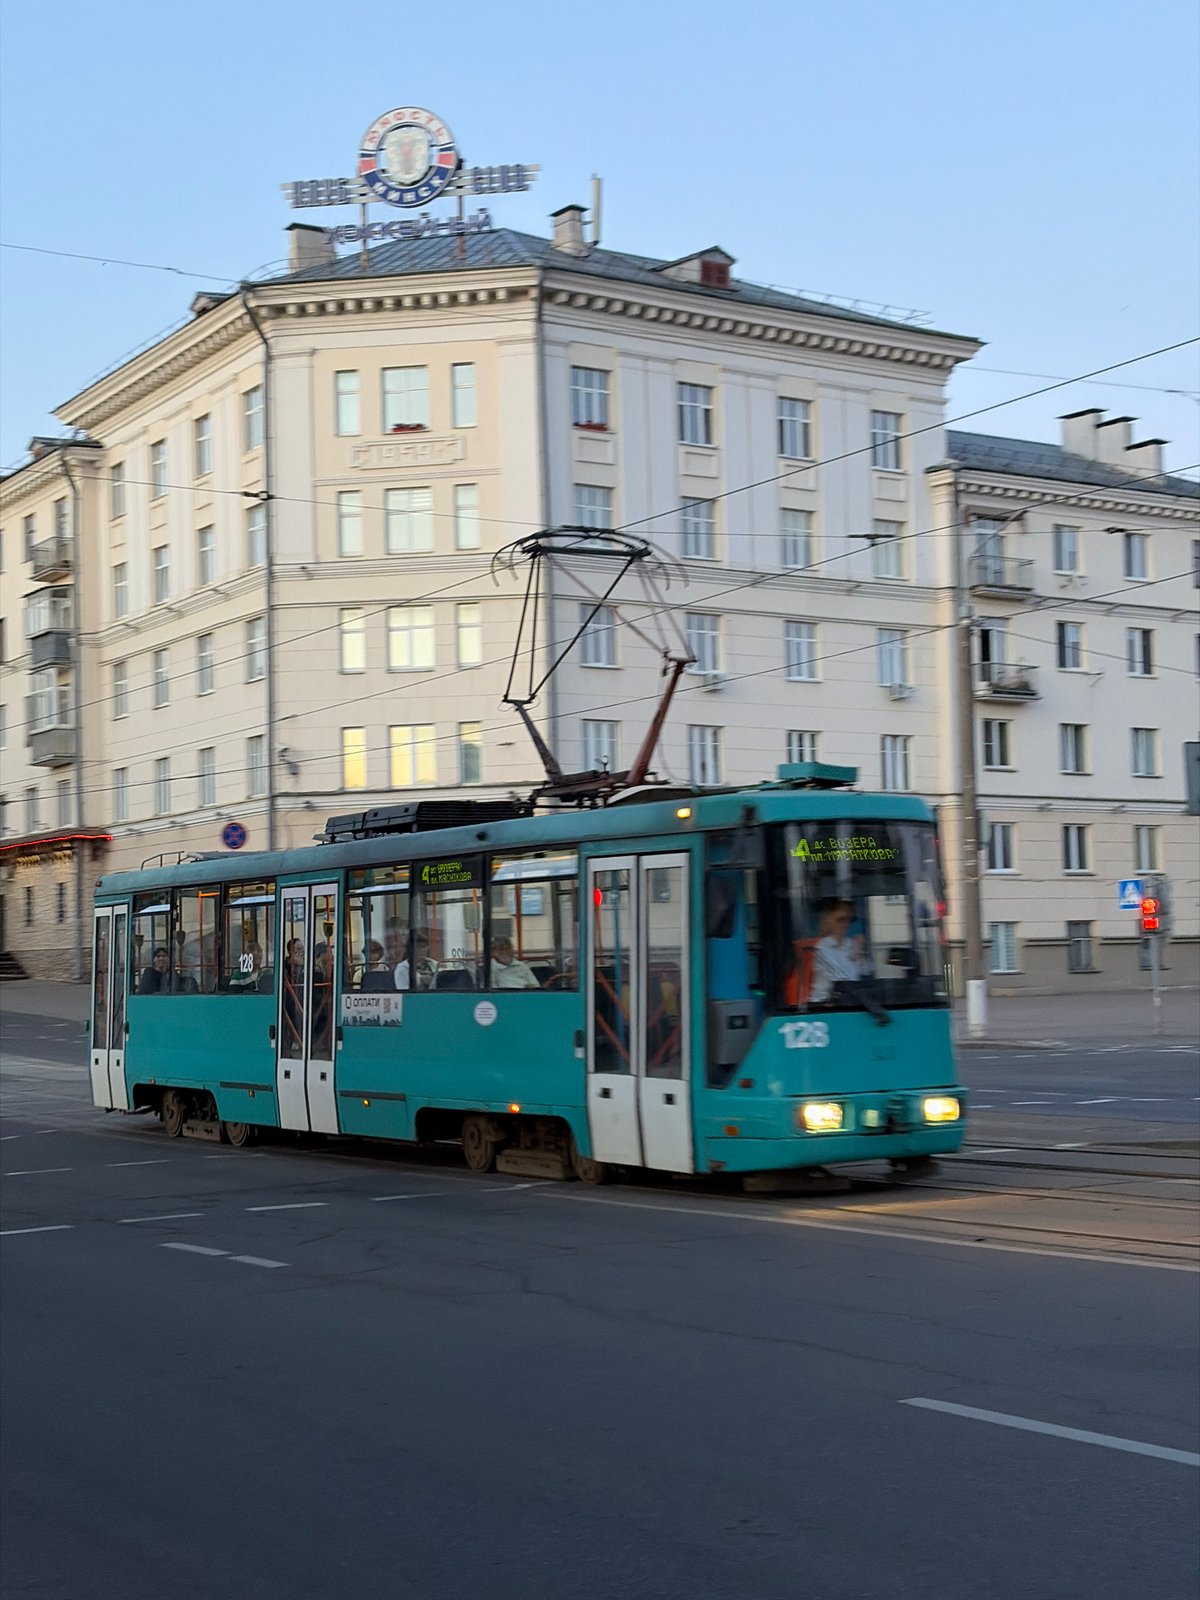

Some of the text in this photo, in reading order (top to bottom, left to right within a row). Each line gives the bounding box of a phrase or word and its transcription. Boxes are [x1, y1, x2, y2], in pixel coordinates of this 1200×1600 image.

[366, 110, 447, 145] ЮНОСТЬ
[371, 174, 446, 203] МИНСК
[324, 207, 492, 245] ХОККЕЙНЫЙ
[790, 838, 812, 863] 4
[829, 836, 877, 849] ВОЗЕРА
[421, 864, 430, 885] 4
[238, 953, 254, 973] 128
[778, 1021, 830, 1048] 128
